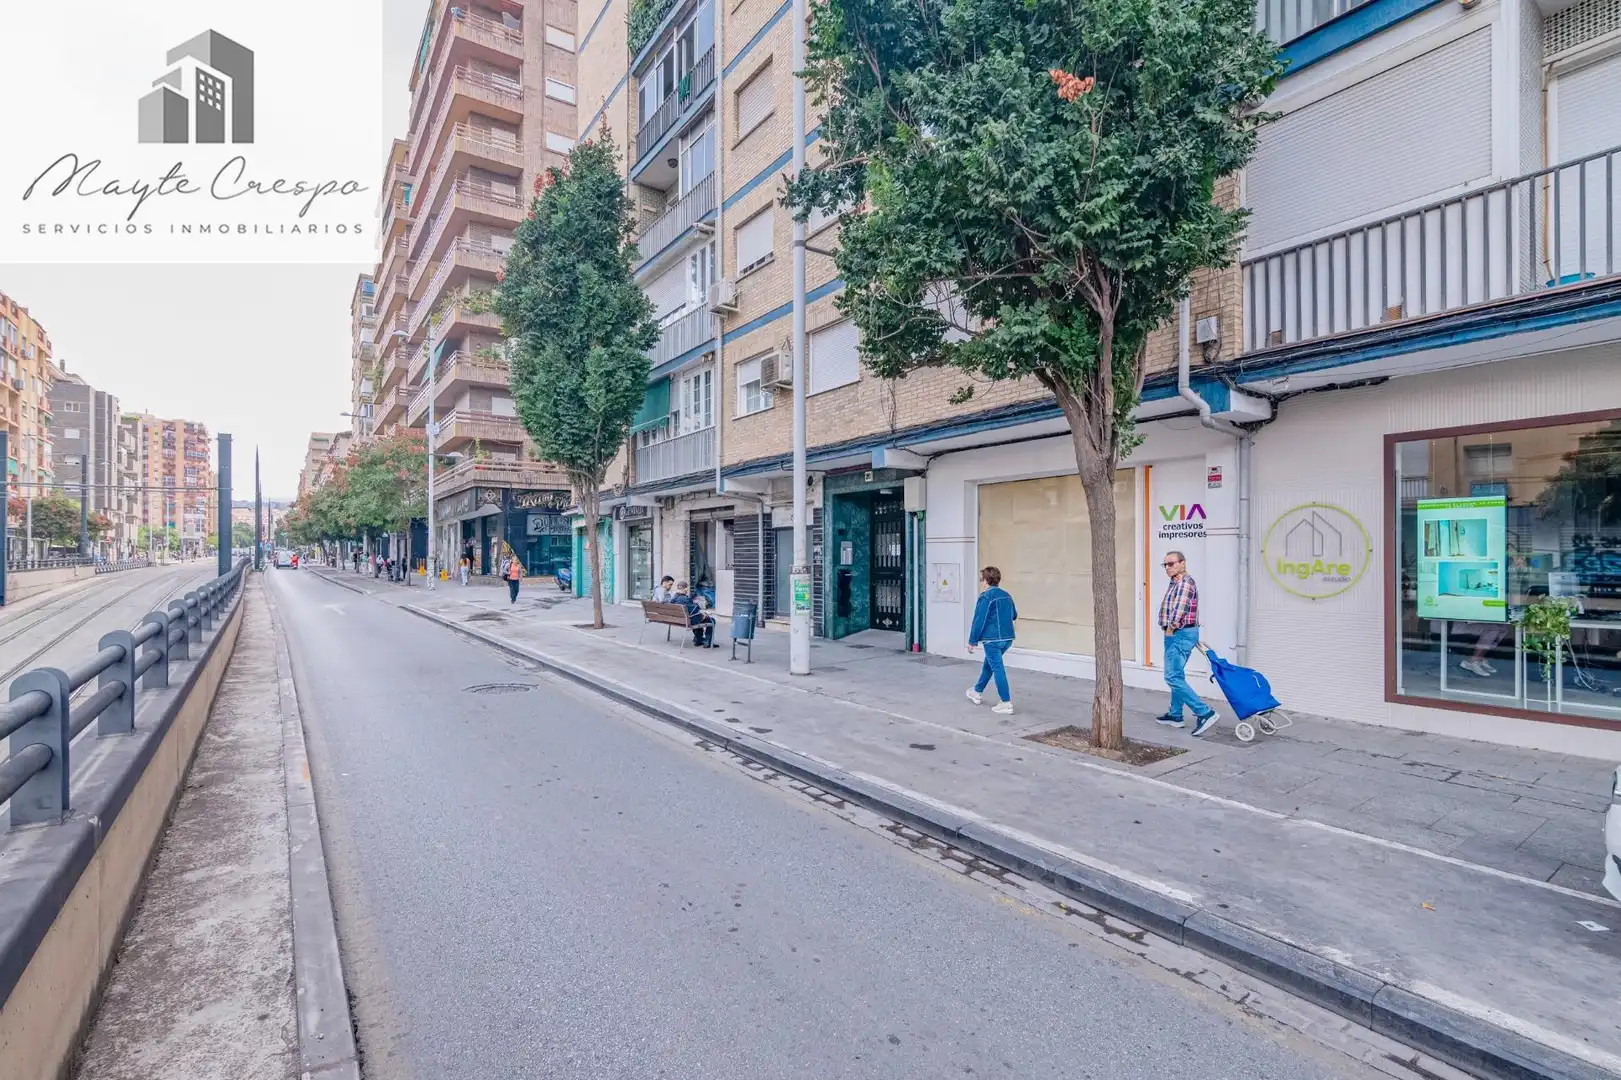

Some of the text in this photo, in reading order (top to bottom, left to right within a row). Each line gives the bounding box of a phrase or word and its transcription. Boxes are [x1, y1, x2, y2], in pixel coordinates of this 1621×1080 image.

[1158, 503, 1207, 521] VIA
[1162, 522, 1204, 531] creativos
[1158, 530, 1208, 540] impresores
[1276, 558, 1351, 579] IngAre
